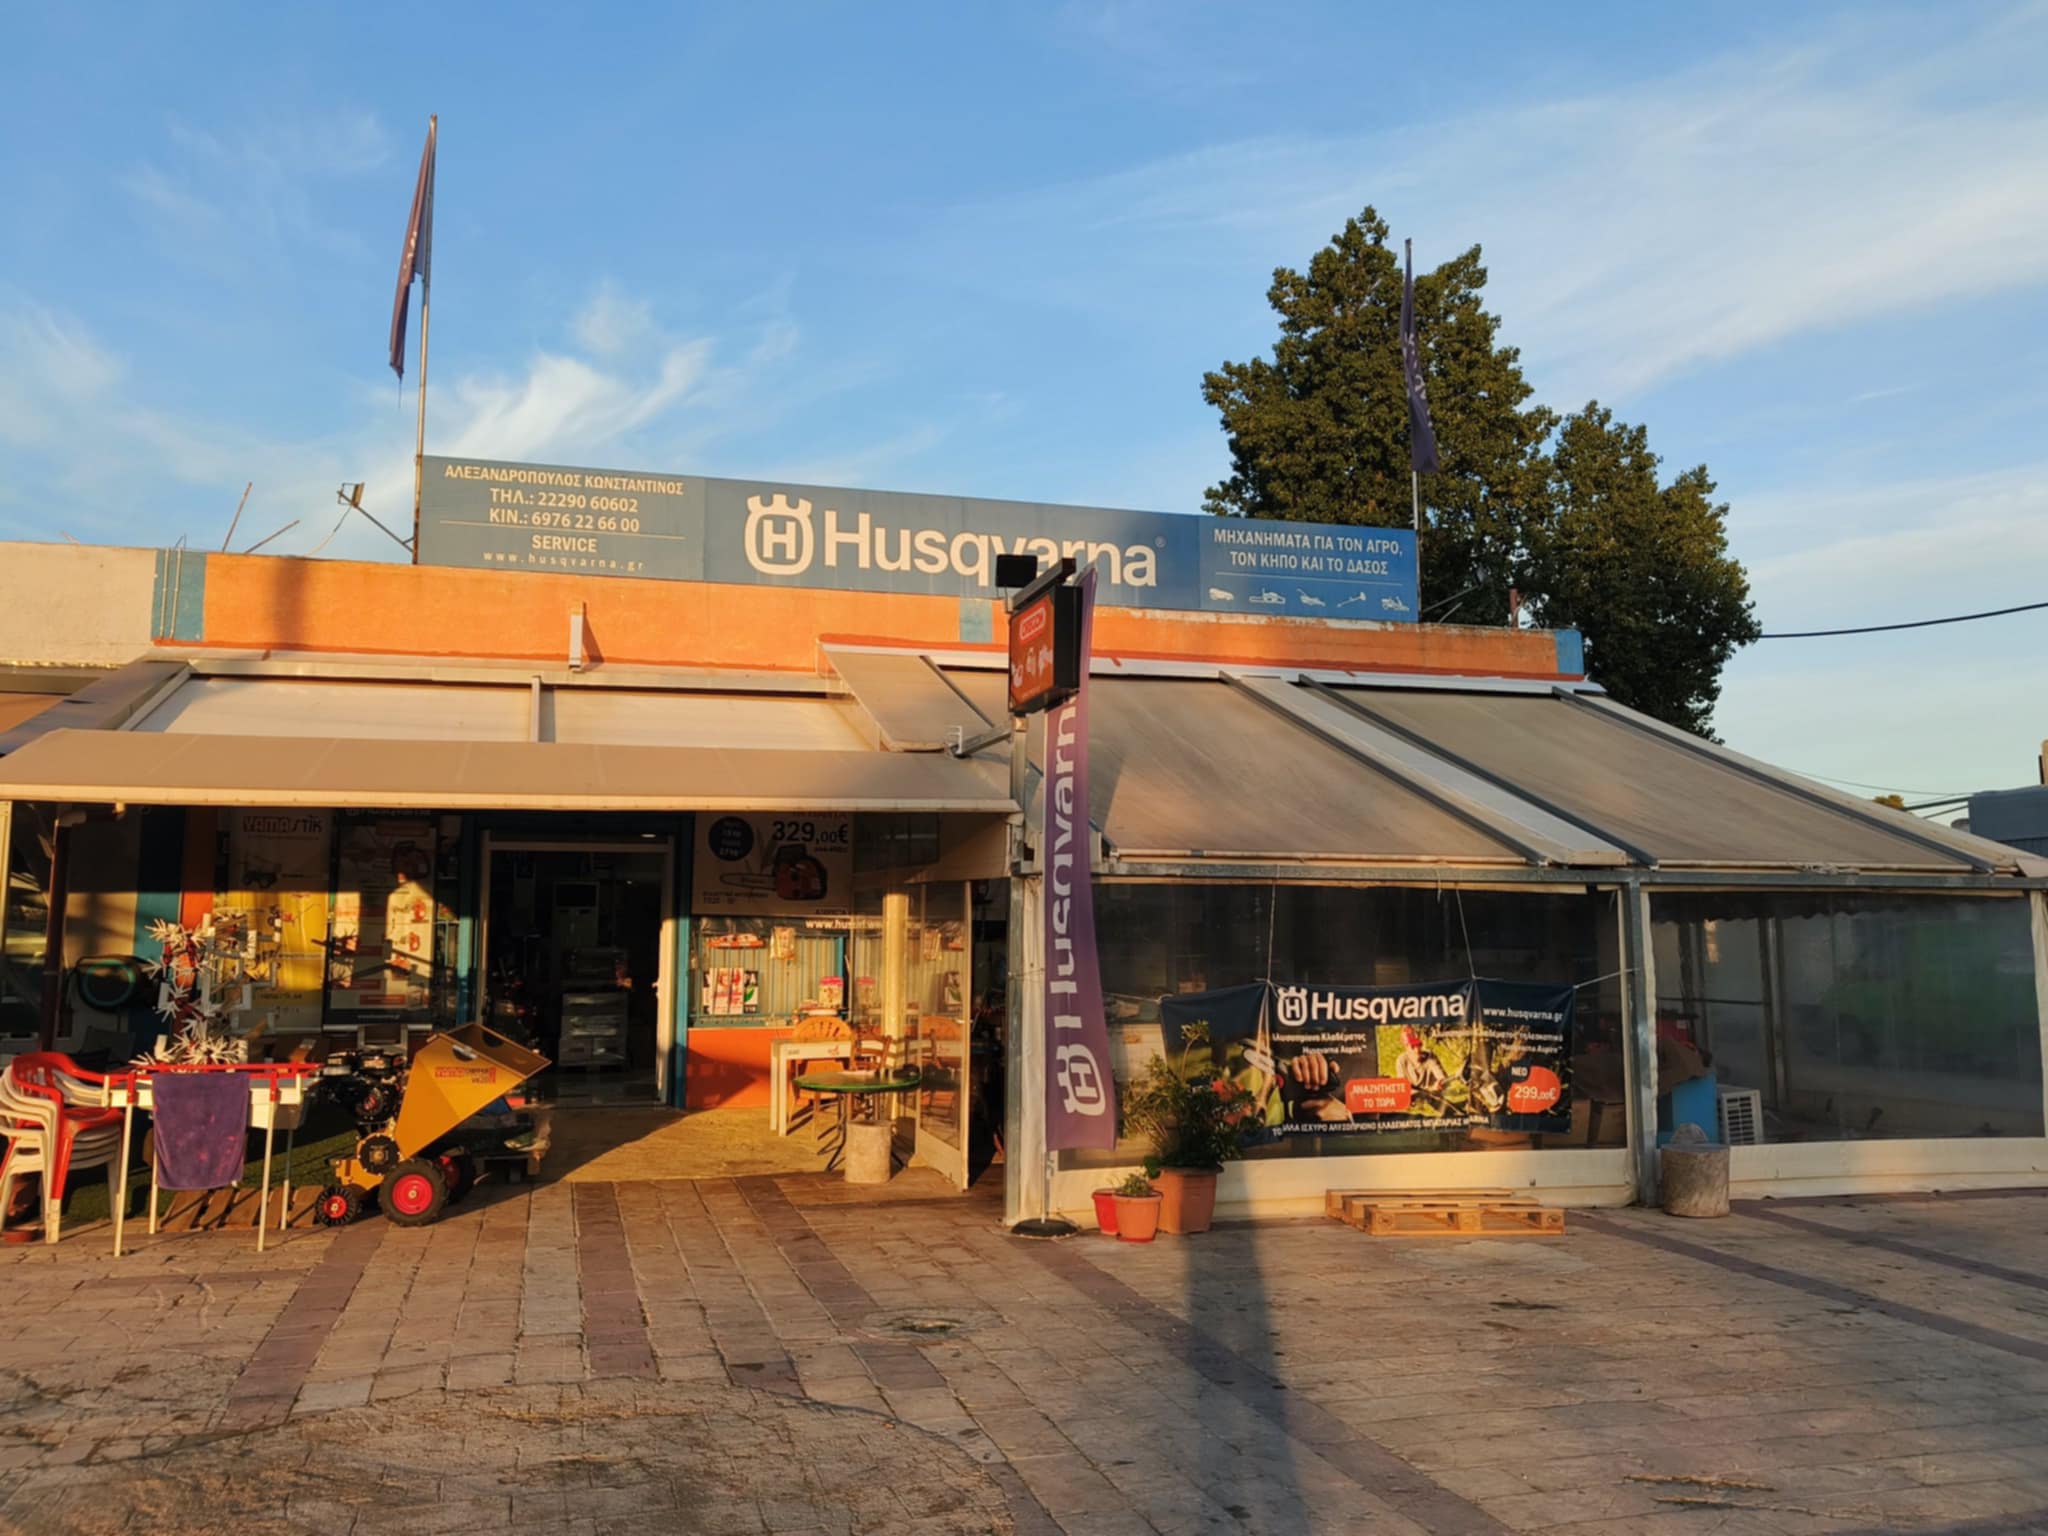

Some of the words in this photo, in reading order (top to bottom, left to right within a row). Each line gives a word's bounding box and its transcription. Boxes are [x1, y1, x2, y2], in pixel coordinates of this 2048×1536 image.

[445, 464, 581, 488] ΑΛΕΞΑΝΔΡΟΠΟΥΛΟΣ
[585, 475, 684, 496] ΚΩΝΣΤΑΝΤΙΝΟΣ
[490, 488, 534, 505] ΤΗΛ.:
[538, 491, 586, 509] 22290
[590, 495, 638, 513] 60602
[489, 508, 528, 525] ΚΙΝ.:
[531, 511, 571, 528] 6976
[575, 514, 594, 530] 22
[598, 515, 617, 532] 66
[621, 517, 640, 533] 00
[531, 534, 598, 552] SERVICE
[1214, 528, 1311, 549] ΜΗΧΑΝΗΜΑΤΑ
[1314, 535, 1334, 550] ΓΙΑ
[1337, 537, 1363, 552] ΤΟΝ
[1366, 538, 1403, 556] ΑΓΡΟ,
[483, 551, 645, 572] www.husqvarna.gr
[1230, 551, 1256, 567] ΤΟΝ
[1261, 554, 1298, 570] ΚΗΠΟ
[1302, 556, 1324, 571] ΚΑΙ
[1326, 557, 1343, 572] ΤΟ
[1347, 559, 1388, 576] ΔΑΣΟΣ
[1311, 991, 1465, 1024] Husqvarna
[1483, 1006, 1563, 1023] www.husqvarna.gr
